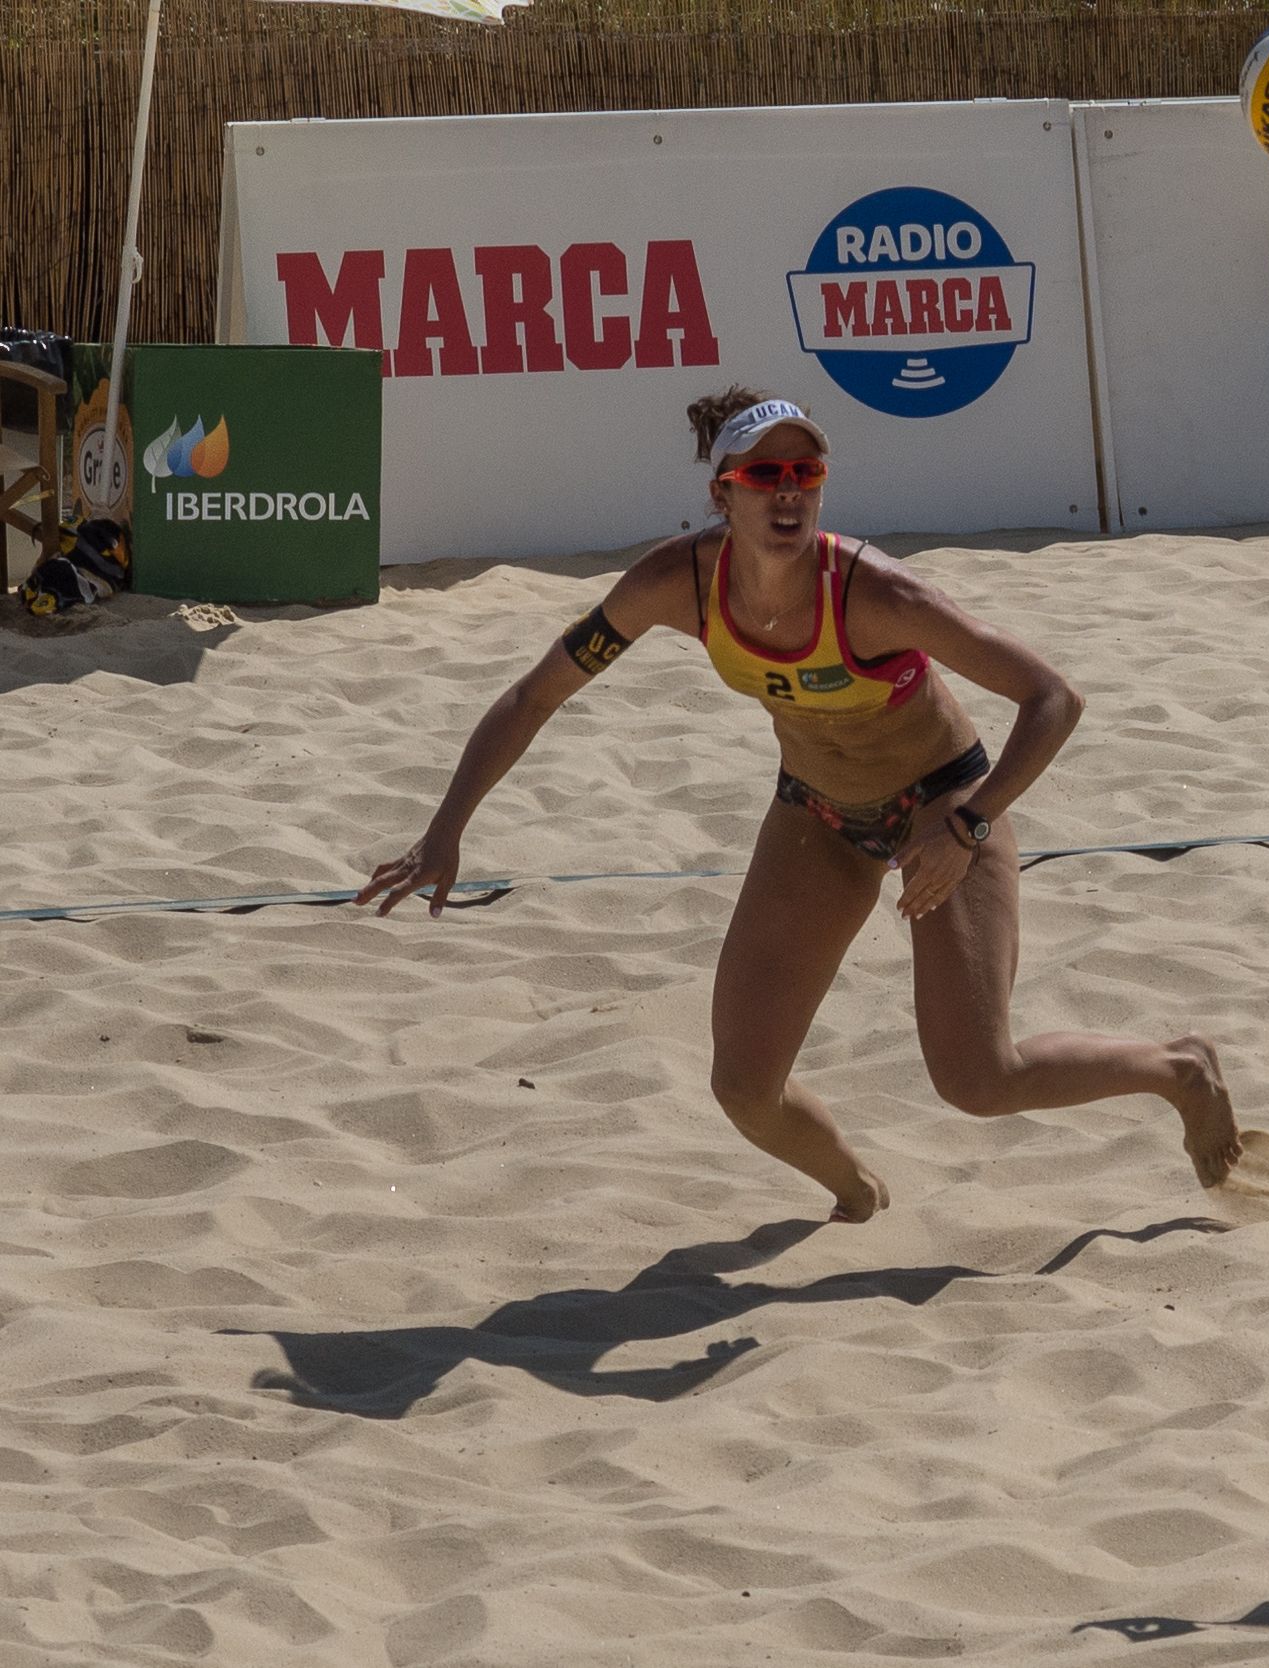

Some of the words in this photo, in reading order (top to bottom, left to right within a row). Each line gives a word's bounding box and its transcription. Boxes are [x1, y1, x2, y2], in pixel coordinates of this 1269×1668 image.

[837, 221, 982, 264] RADIO
[276, 240, 720, 377] MARCA
[820, 276, 1012, 337] MARCA
[83, 450, 121, 490] Gre
[166, 492, 371, 521] IBERDROLA
[589, 632, 620, 660] UC
[765, 671, 796, 702] 2
